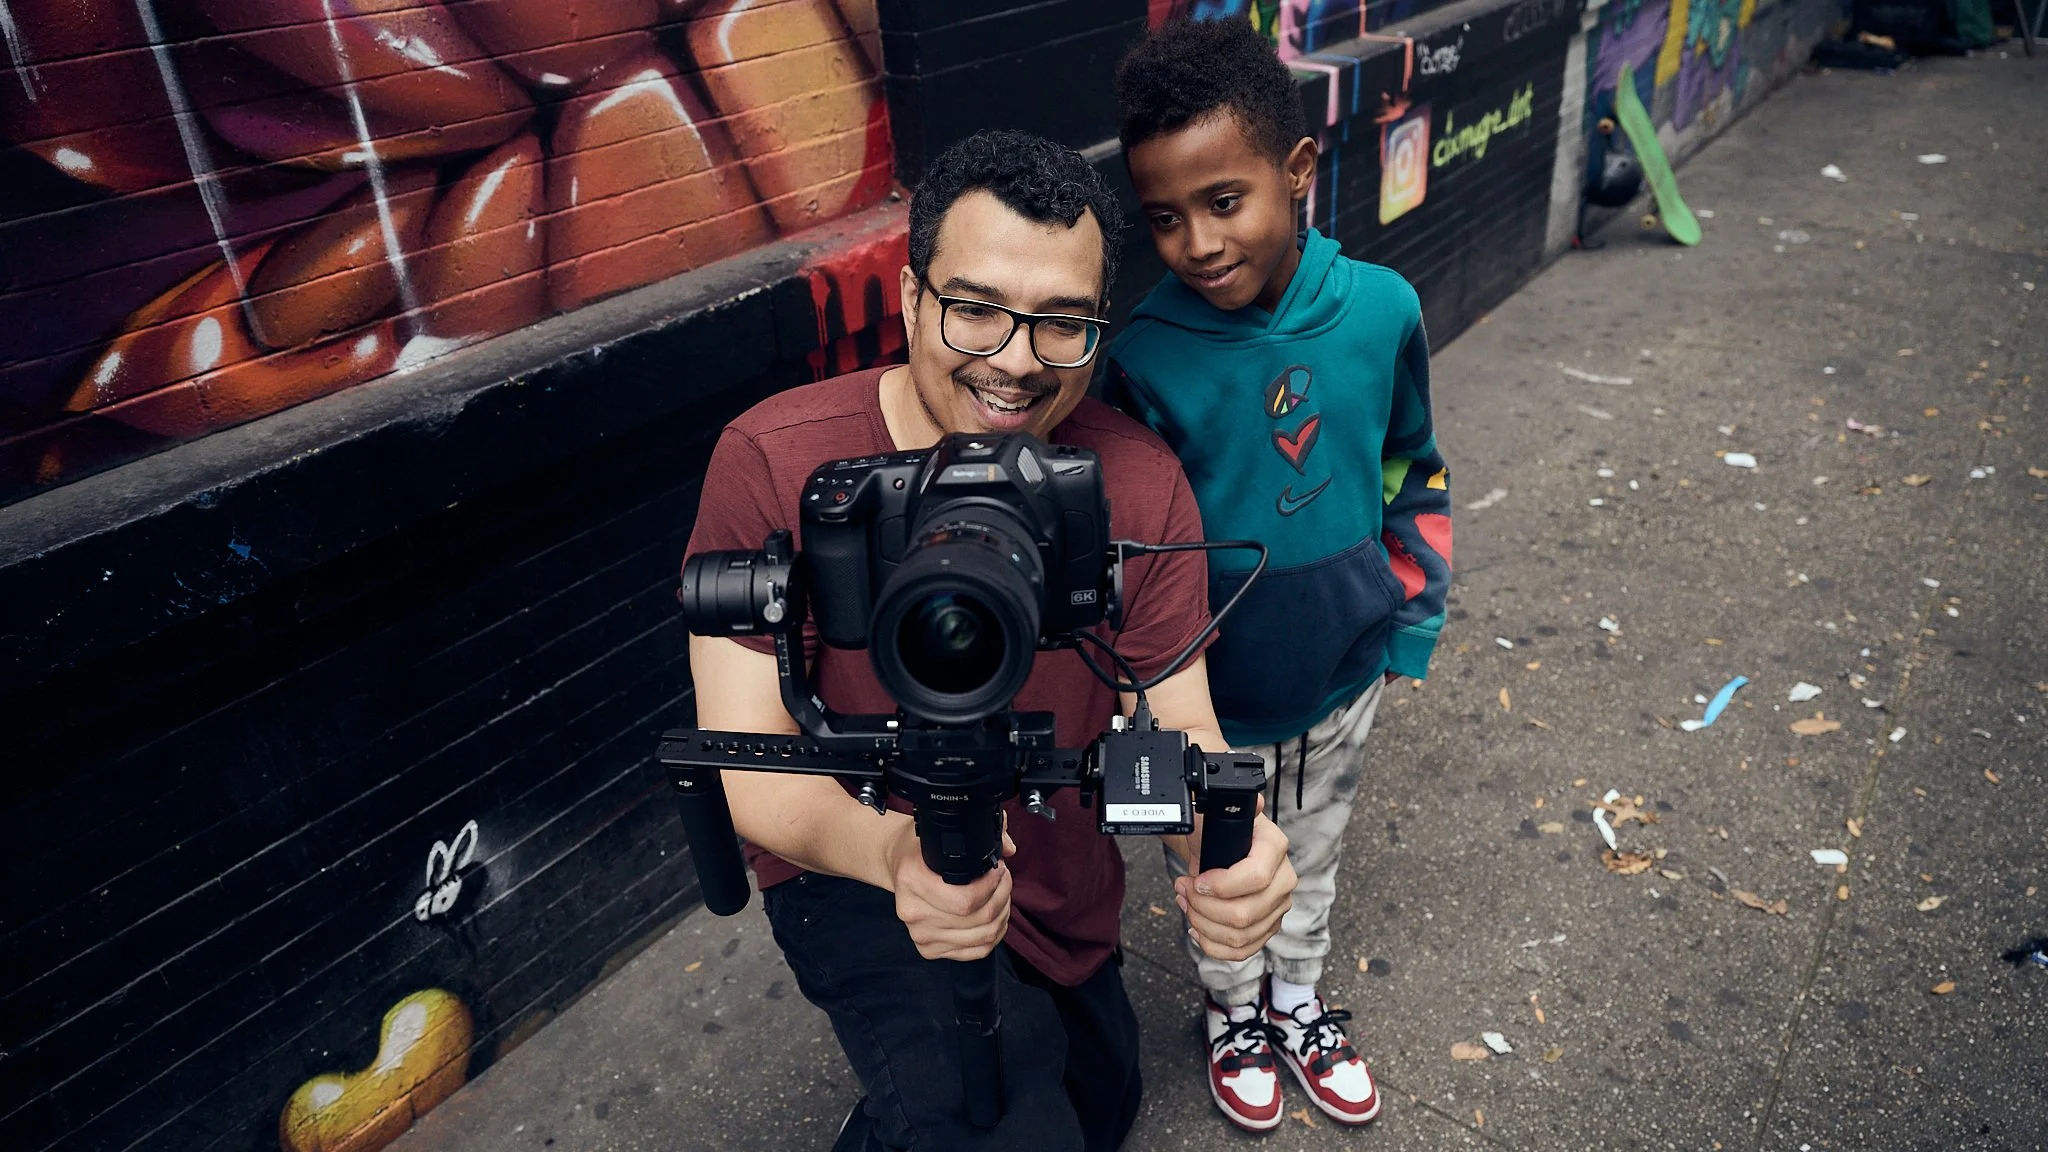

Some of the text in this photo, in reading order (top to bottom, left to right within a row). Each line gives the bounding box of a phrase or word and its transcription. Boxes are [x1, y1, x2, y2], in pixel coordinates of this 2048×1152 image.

[1074, 592, 1093, 602] 6K
[1140, 756, 1150, 795] SAMSUNG
[1131, 808, 1166, 816] VIDEO
